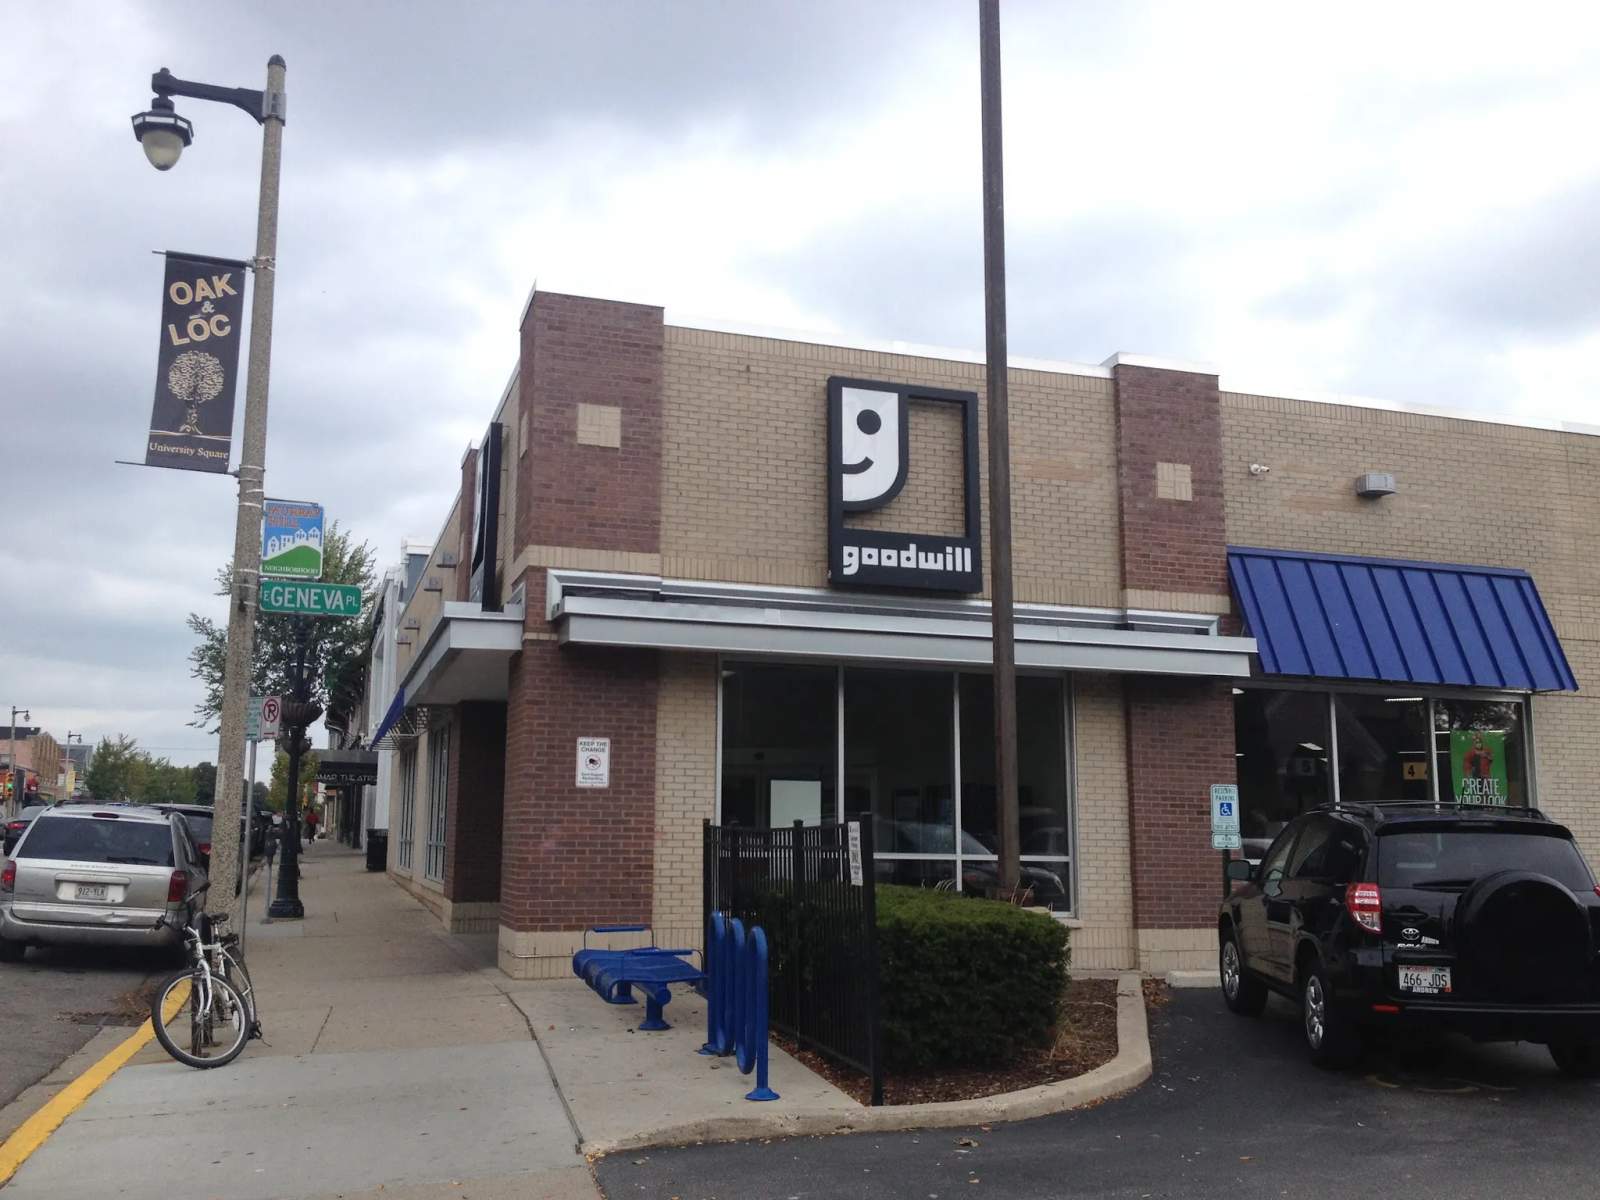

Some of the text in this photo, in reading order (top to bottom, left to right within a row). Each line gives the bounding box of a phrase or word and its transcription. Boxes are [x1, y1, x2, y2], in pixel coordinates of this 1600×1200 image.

[169, 273, 238, 305] OAK
[201, 301, 215, 313] &
[150, 442, 229, 459] University Square
[843, 543, 972, 575] goodwill
[264, 586, 358, 610] E GENEVA PL
[1462, 778, 1500, 795] CREATE
